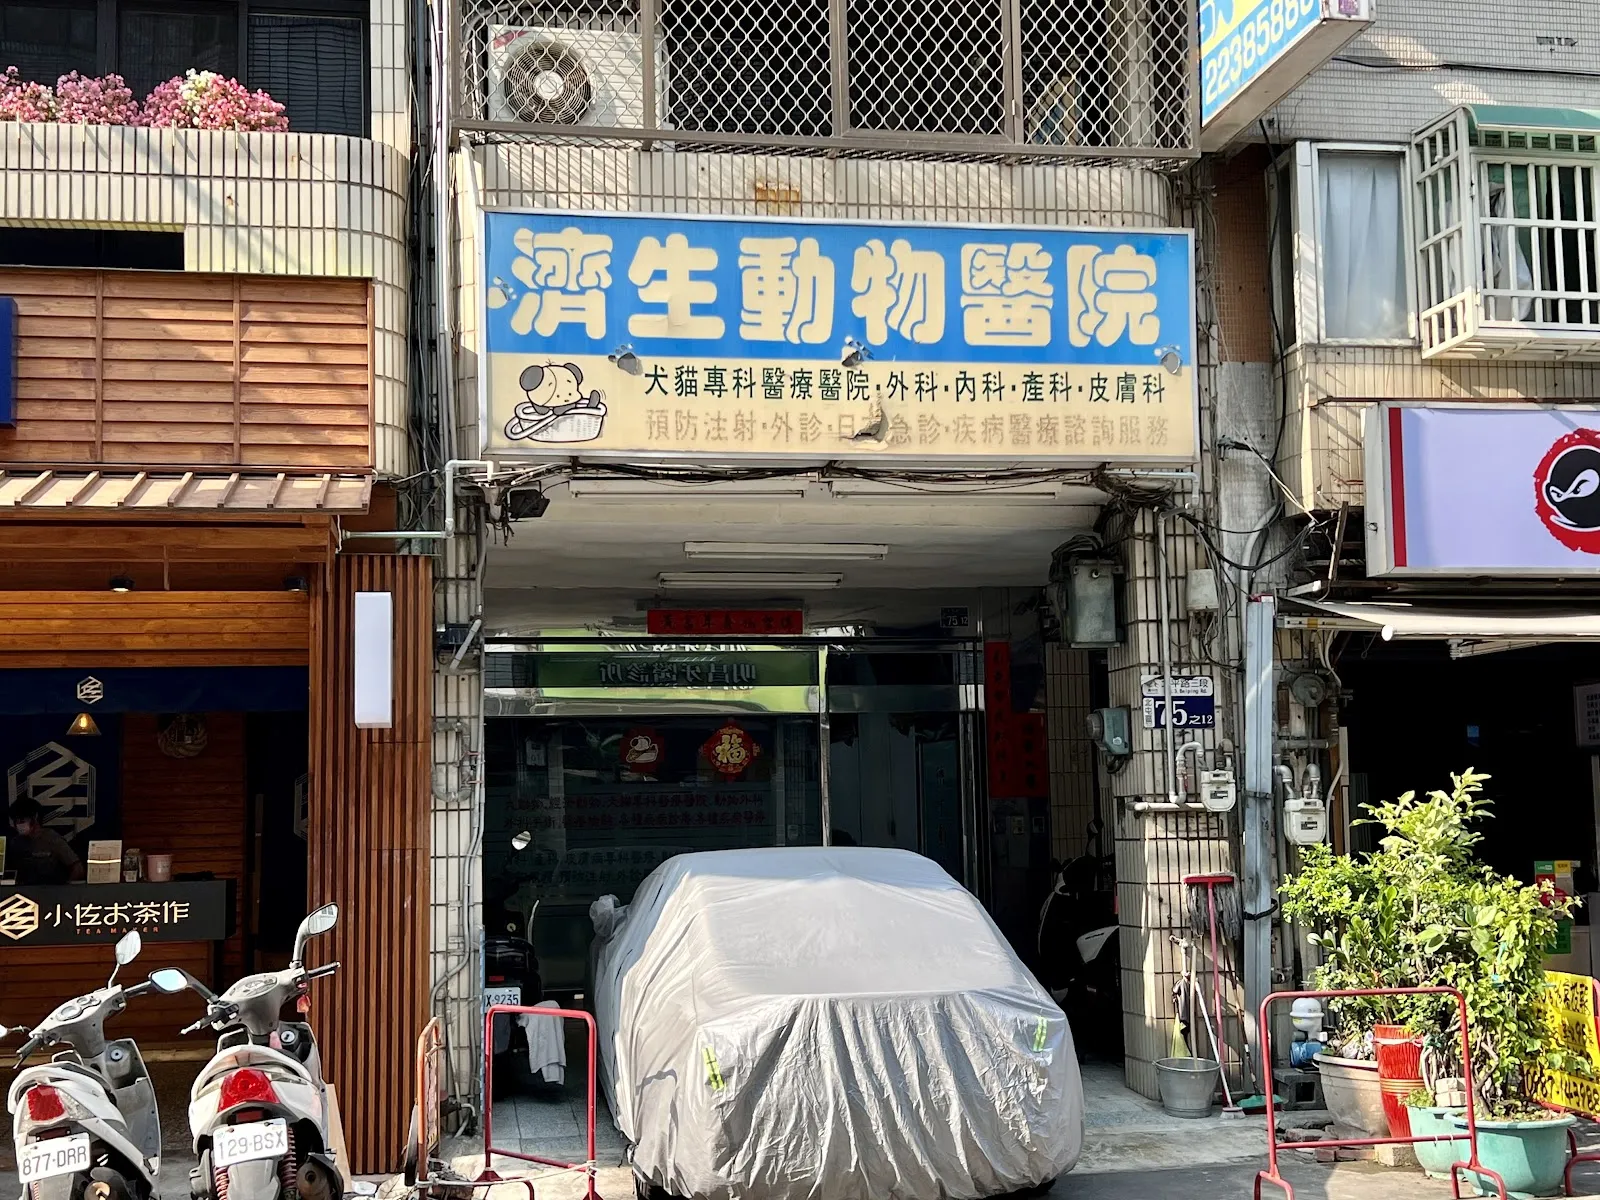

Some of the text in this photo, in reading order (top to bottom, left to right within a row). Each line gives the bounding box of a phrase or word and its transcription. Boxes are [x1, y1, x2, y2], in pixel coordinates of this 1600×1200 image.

[510, 226, 1161, 347] 濟生動物醫院
[715, 733, 746, 764] 福
[44, 901, 190, 927] 小佐お茶作
